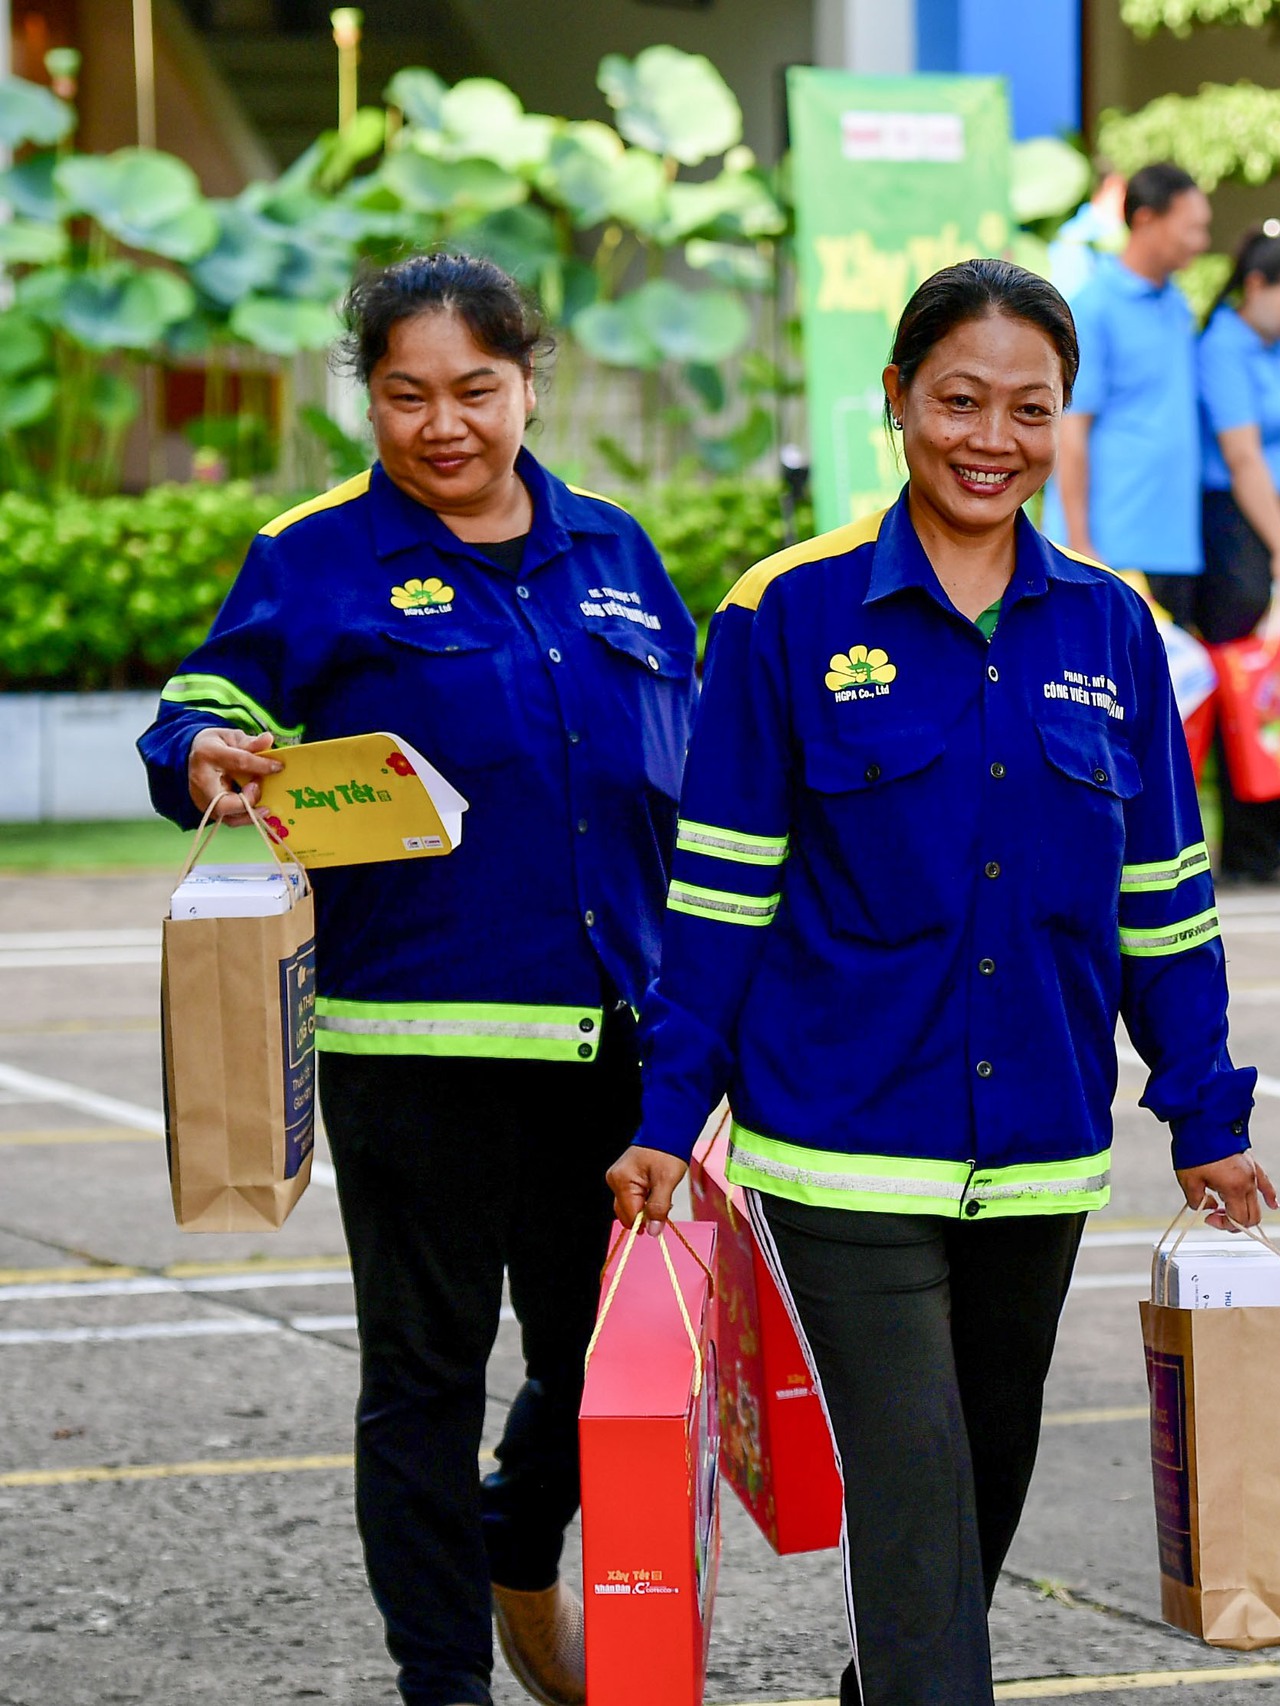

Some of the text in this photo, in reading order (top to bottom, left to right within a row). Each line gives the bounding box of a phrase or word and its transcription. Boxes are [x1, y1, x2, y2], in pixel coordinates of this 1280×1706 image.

[835, 689, 857, 703] HGPA
[875, 684, 890, 696] Ltd
[1043, 681, 1069, 700] CÔNG
[1069, 686, 1090, 706] VIÊN
[286, 780, 376, 812] Xây Tết
[607, 1570, 629, 1583] Xây
